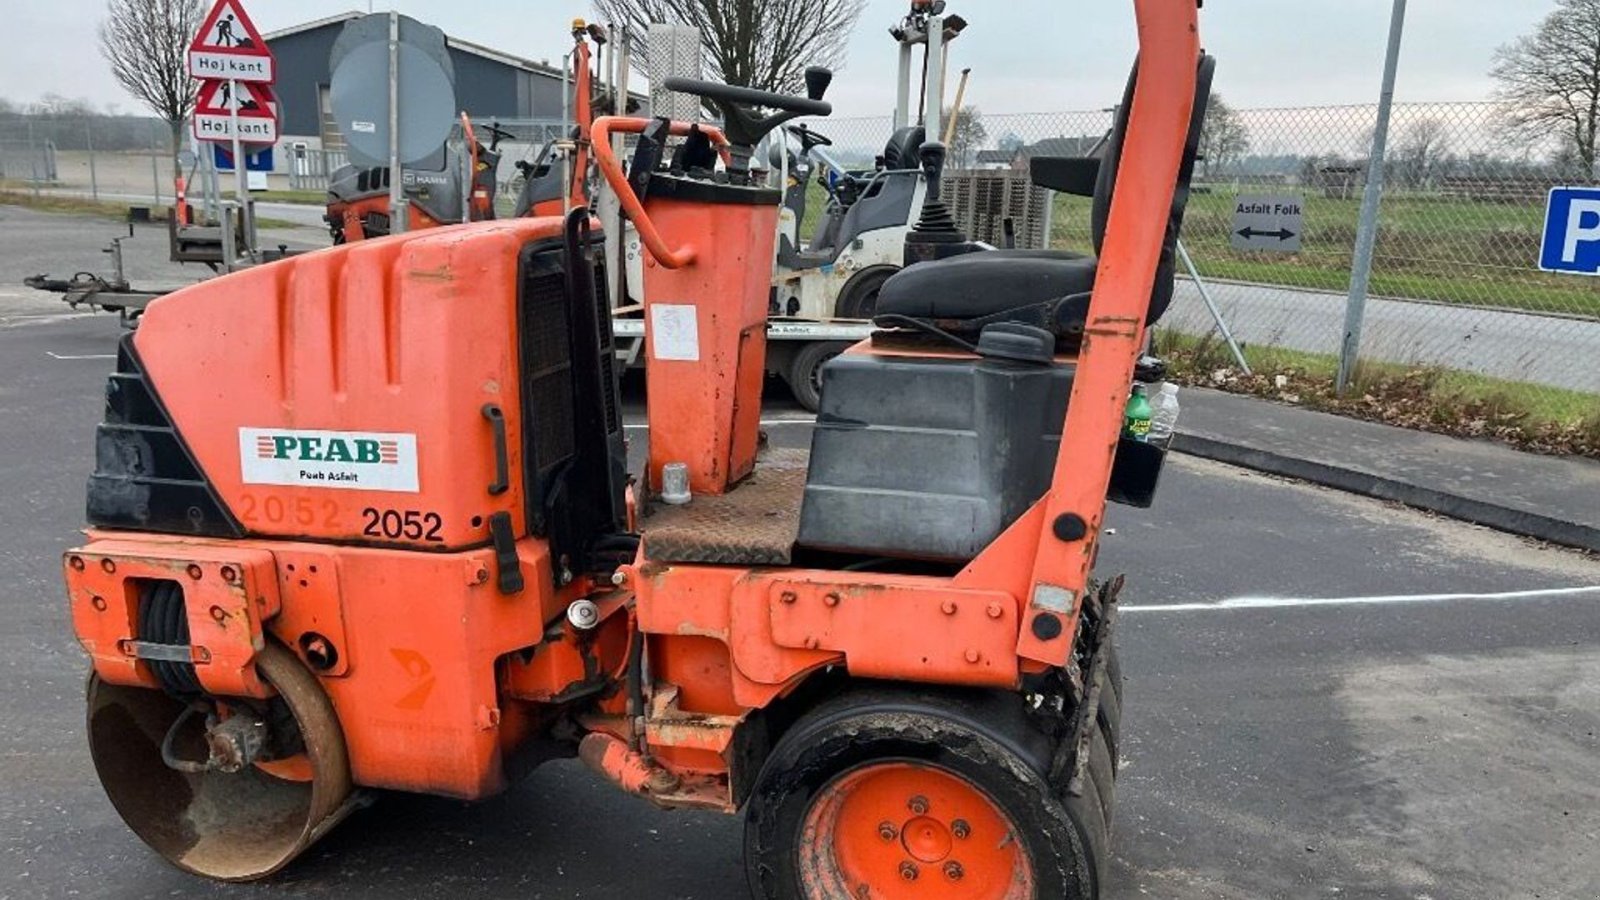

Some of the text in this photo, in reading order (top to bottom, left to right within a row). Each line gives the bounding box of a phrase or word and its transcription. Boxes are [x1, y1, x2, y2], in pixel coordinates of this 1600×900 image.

[199, 57, 264, 73] Høj kant
[201, 119, 228, 134] Høj
[416, 176, 447, 185] HAMM
[1236, 203, 1301, 215] Asfalt Folk
[1561, 198, 1600, 263] P
[272, 435, 382, 464] PEAB
[299, 469, 359, 482] Peab Asfalt
[240, 493, 342, 529] 2052
[362, 507, 443, 542] 2052
